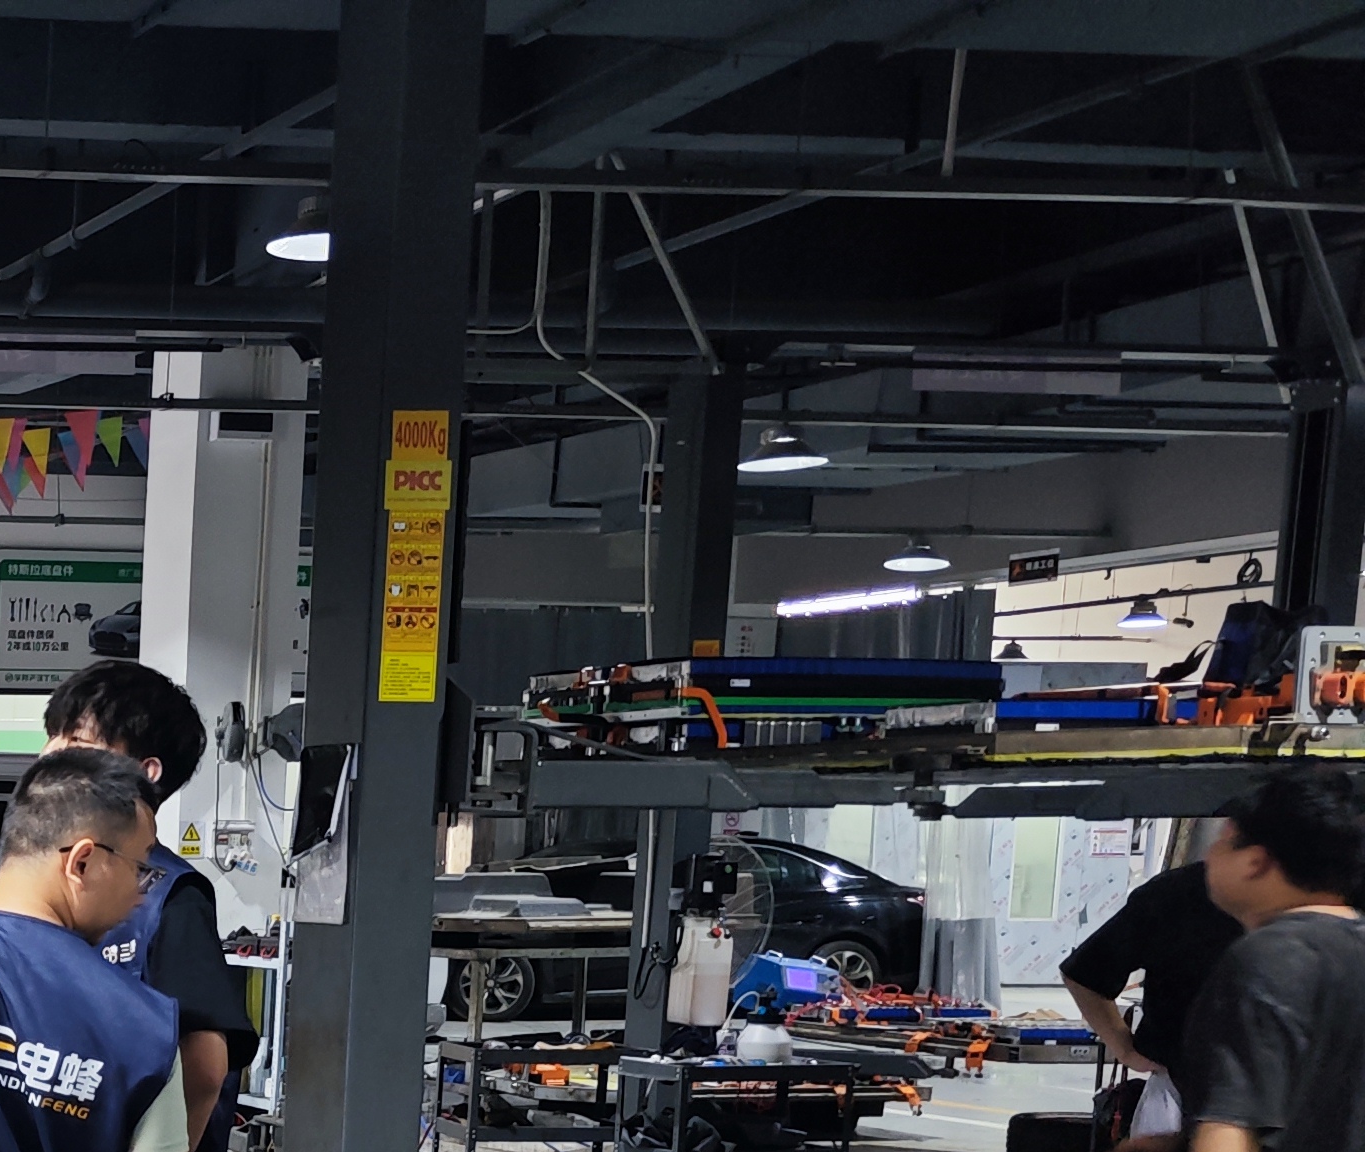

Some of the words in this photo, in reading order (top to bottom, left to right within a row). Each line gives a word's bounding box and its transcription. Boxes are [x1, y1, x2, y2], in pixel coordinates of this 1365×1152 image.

[395, 421, 446, 454] 4000Kg
[394, 470, 442, 491] PICC
[8, 564, 73, 577] 特斯拉底盘件
